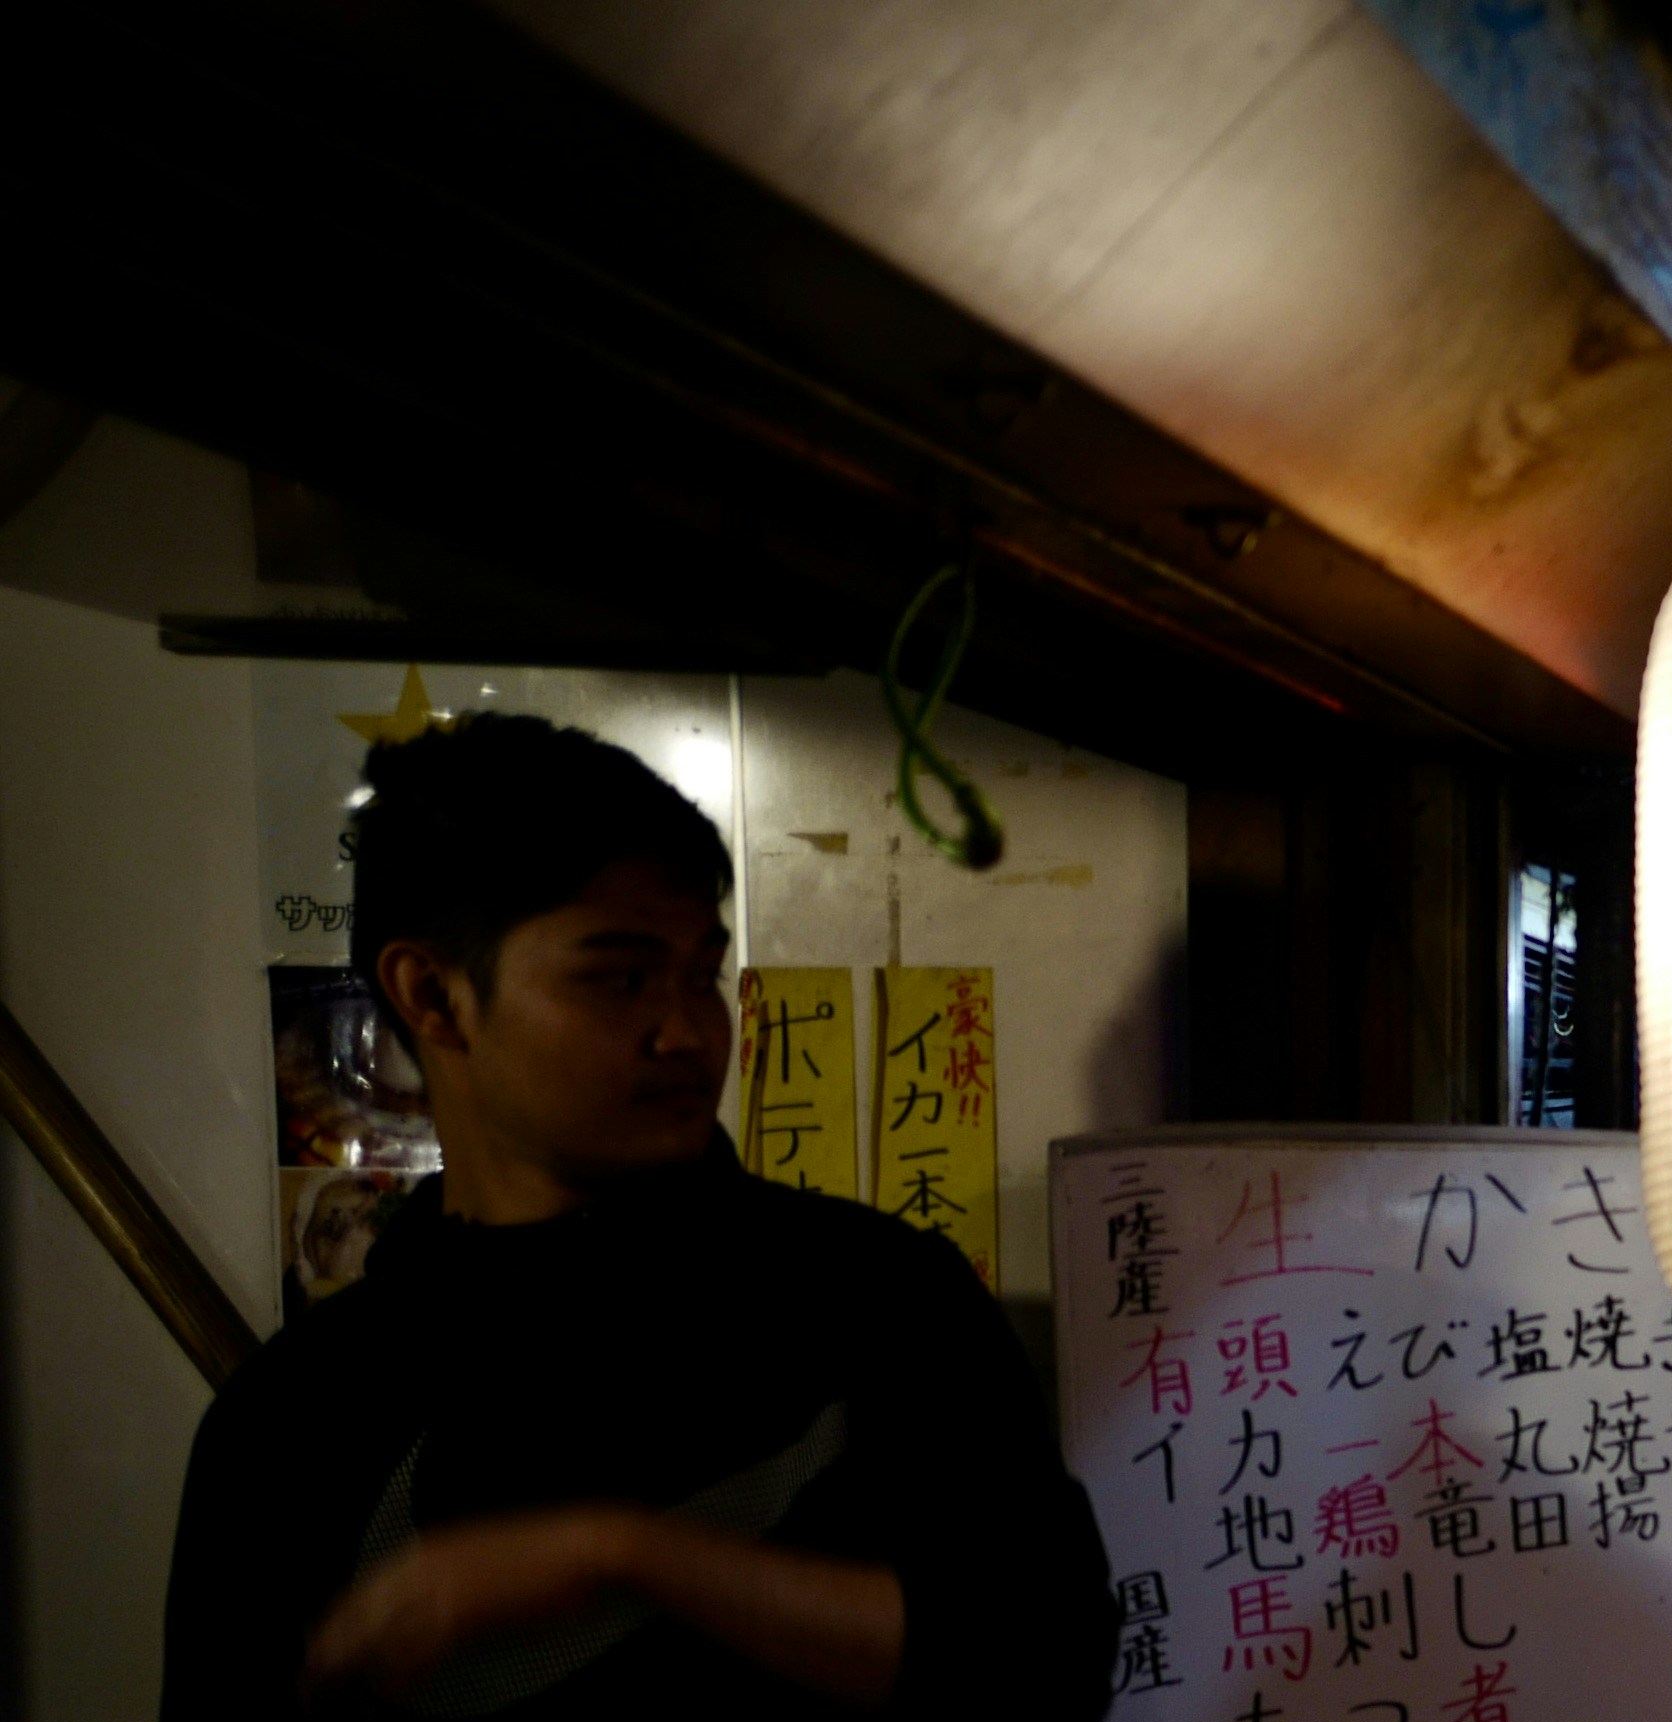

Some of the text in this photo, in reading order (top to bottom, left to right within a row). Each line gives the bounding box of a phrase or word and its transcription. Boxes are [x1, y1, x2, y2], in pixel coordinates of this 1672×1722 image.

[1102, 1163, 1180, 1319] 三陸産
[1215, 1168, 1638, 1286] 生かき
[1204, 1473, 1661, 1573] 地鶏竜田揚
[1116, 1569, 1182, 1695] 国産
[1223, 1568, 1516, 1682] 馬刺し
